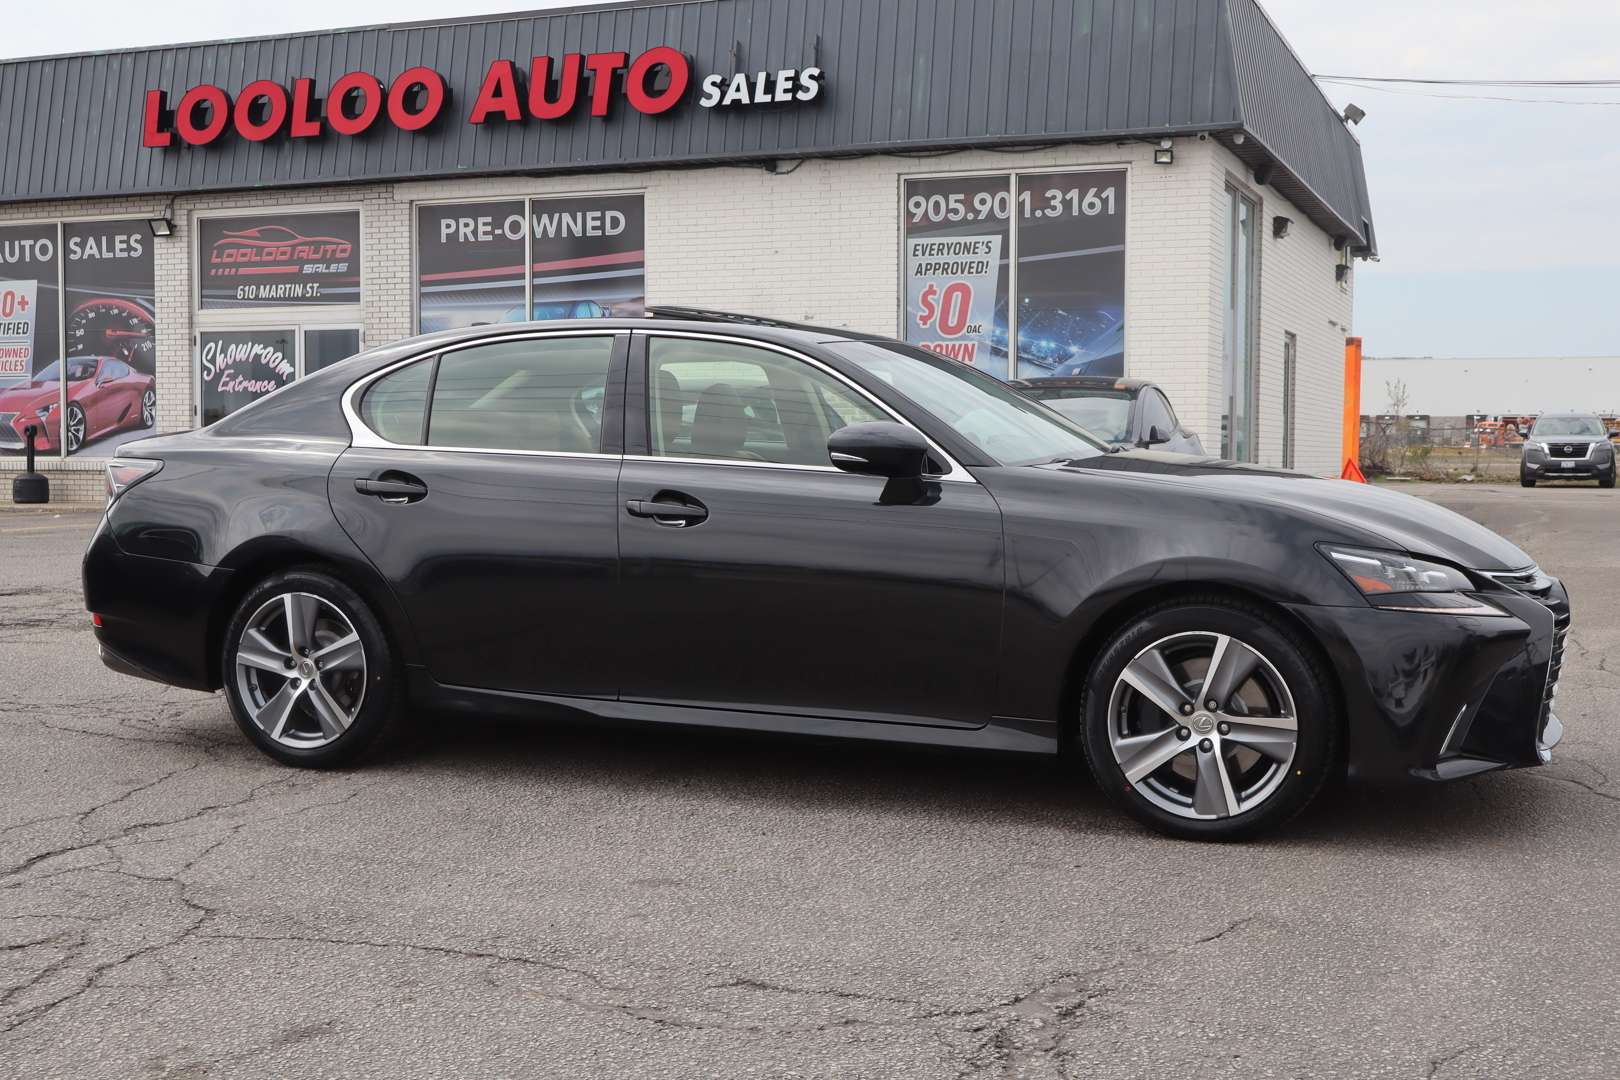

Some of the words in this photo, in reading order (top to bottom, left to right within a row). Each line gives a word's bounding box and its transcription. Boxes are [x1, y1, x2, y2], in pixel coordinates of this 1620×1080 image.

[143, 66, 444, 148] LOOLOO
[469, 45, 690, 125] AUTO
[699, 66, 822, 108] SALES
[907, 186, 1117, 223] 905.901.3161
[439, 210, 627, 243] PRE-OWNED
[0, 238, 54, 264] UTO
[69, 233, 143, 261] SALES
[210, 247, 291, 264] LOOLOO
[293, 244, 353, 261] AUTO
[912, 240, 993, 257] EVERYONE'S
[302, 262, 349, 274] SALES
[914, 260, 989, 277] APPROVED!
[236, 284, 257, 300] 610
[258, 283, 304, 299] MARTIN
[305, 282, 321, 298] ST.
[918, 282, 972, 337] $0
[202, 339, 295, 381] Showroom
[217, 369, 277, 393] Entrance
